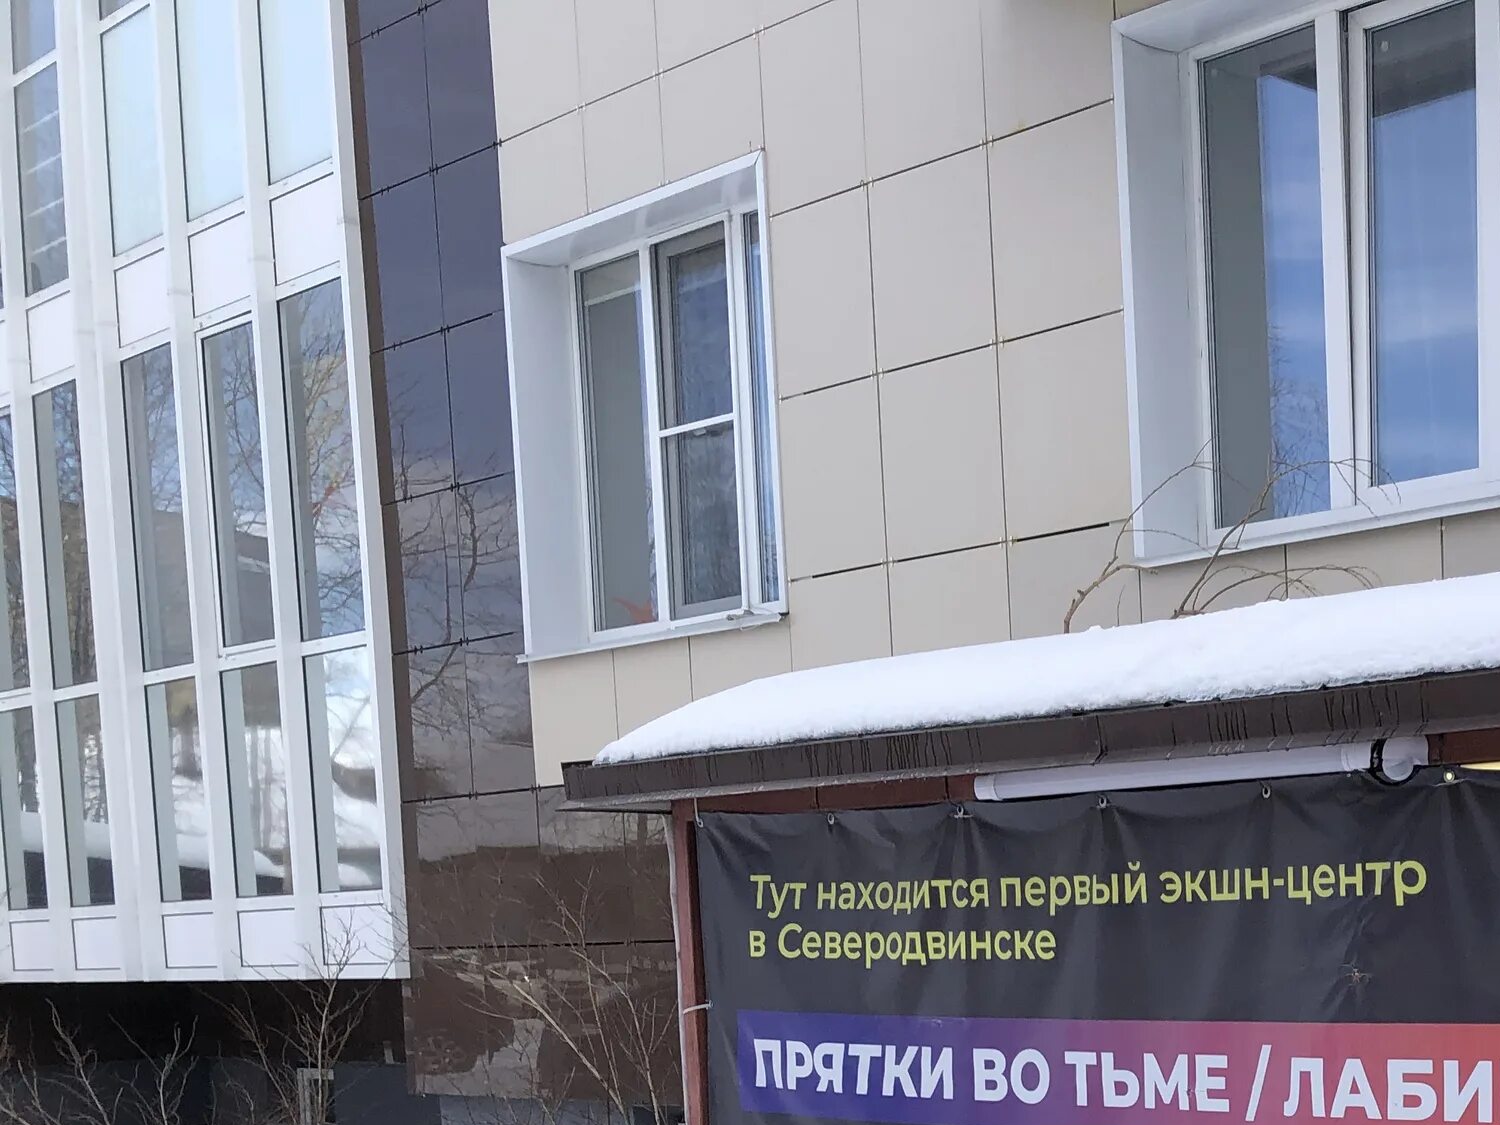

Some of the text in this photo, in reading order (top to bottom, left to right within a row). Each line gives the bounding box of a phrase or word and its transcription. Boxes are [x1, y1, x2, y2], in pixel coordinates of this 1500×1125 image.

[750, 858, 1428, 919] Тут находится первый экшн-центр
[749, 922, 1057, 969] в Северодвинске
[753, 1037, 955, 1100] ПРЯТКИ
[973, 1048, 1050, 1105] ВО
[1064, 1051, 1230, 1113] ТЬМЕ
[1245, 1044, 1272, 1121] /
